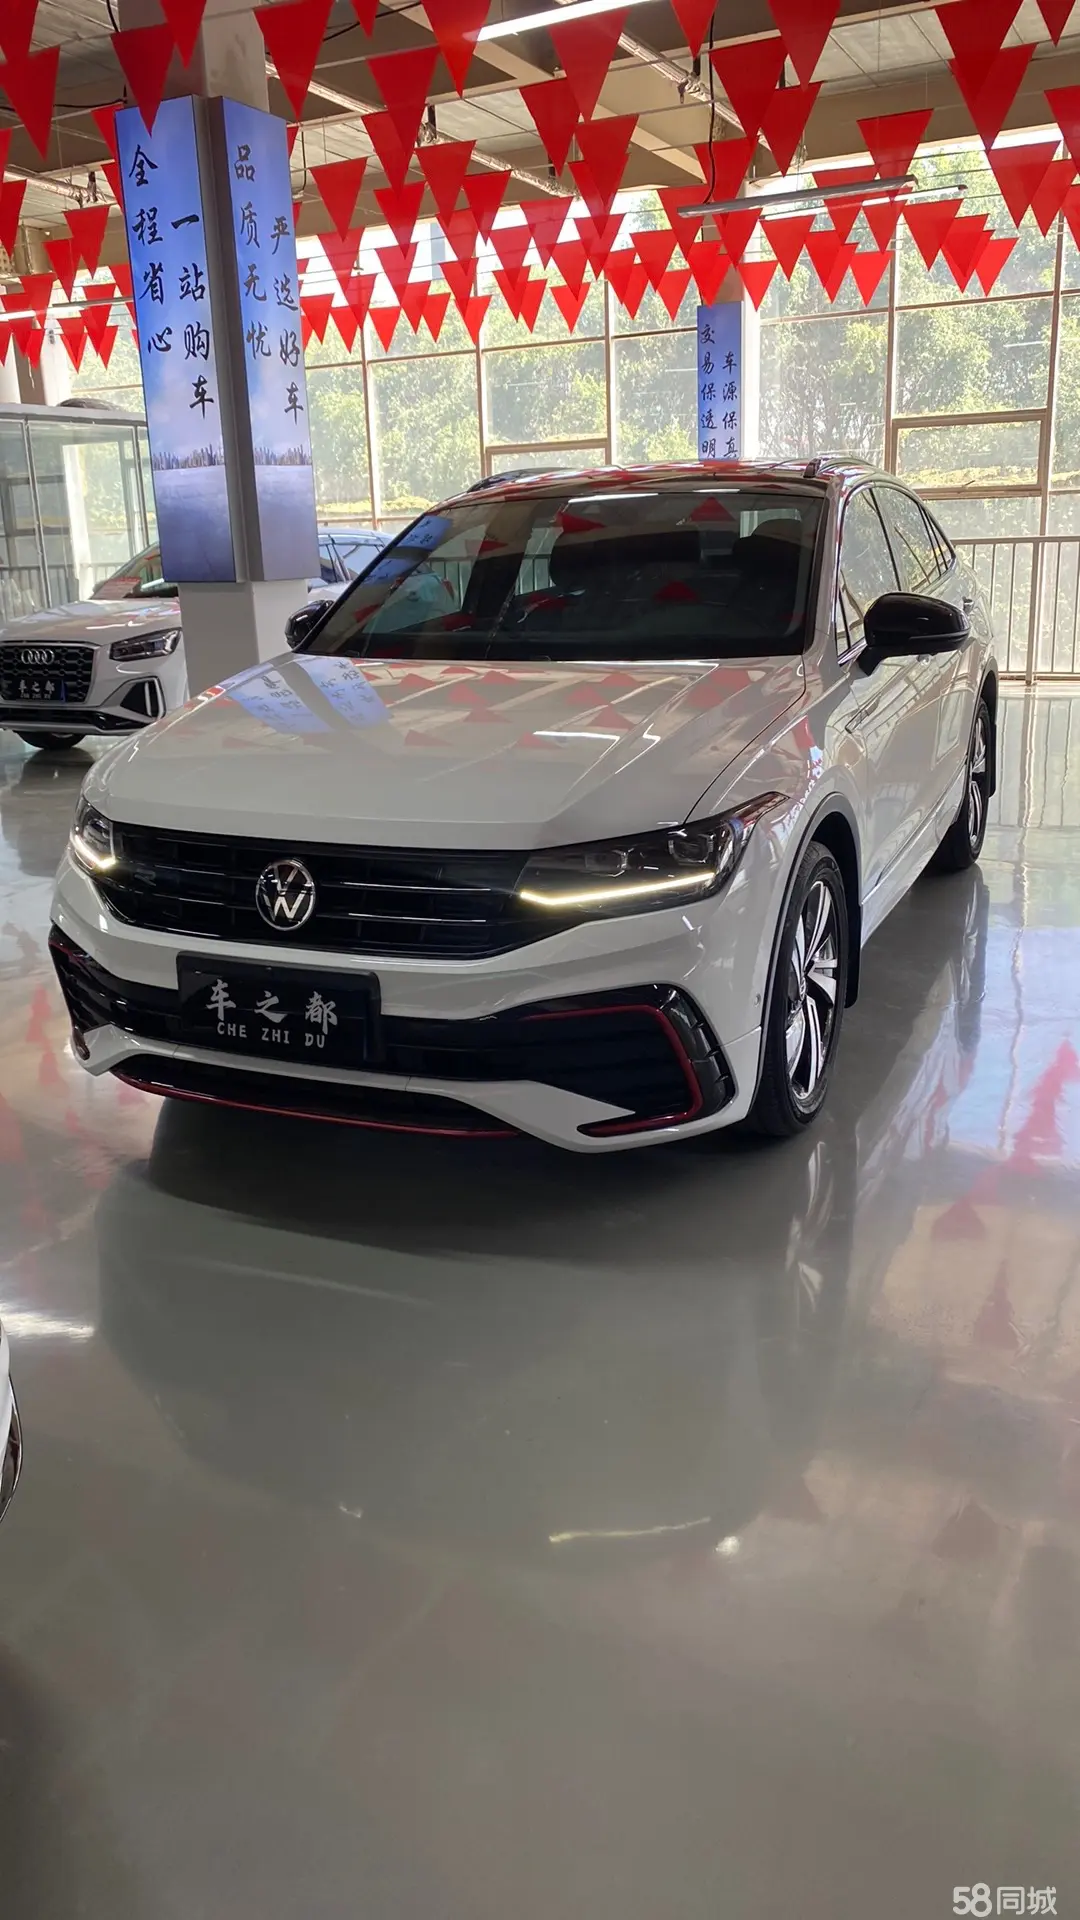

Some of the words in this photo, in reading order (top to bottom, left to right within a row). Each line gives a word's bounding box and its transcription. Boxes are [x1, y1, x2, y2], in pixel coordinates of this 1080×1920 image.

[128, 143, 173, 355] 全程省心
[169, 212, 215, 420] 一站购车
[234, 144, 273, 361] 品质无忧
[270, 215, 304, 426] 严选好车
[700, 324, 717, 459] 交易保透明
[722, 350, 738, 459] 车源保真
[206, 978, 338, 1036] 车之都
[216, 1021, 248, 1038] CHE
[261, 1027, 290, 1045] ZHI
[304, 1032, 326, 1049] DU
